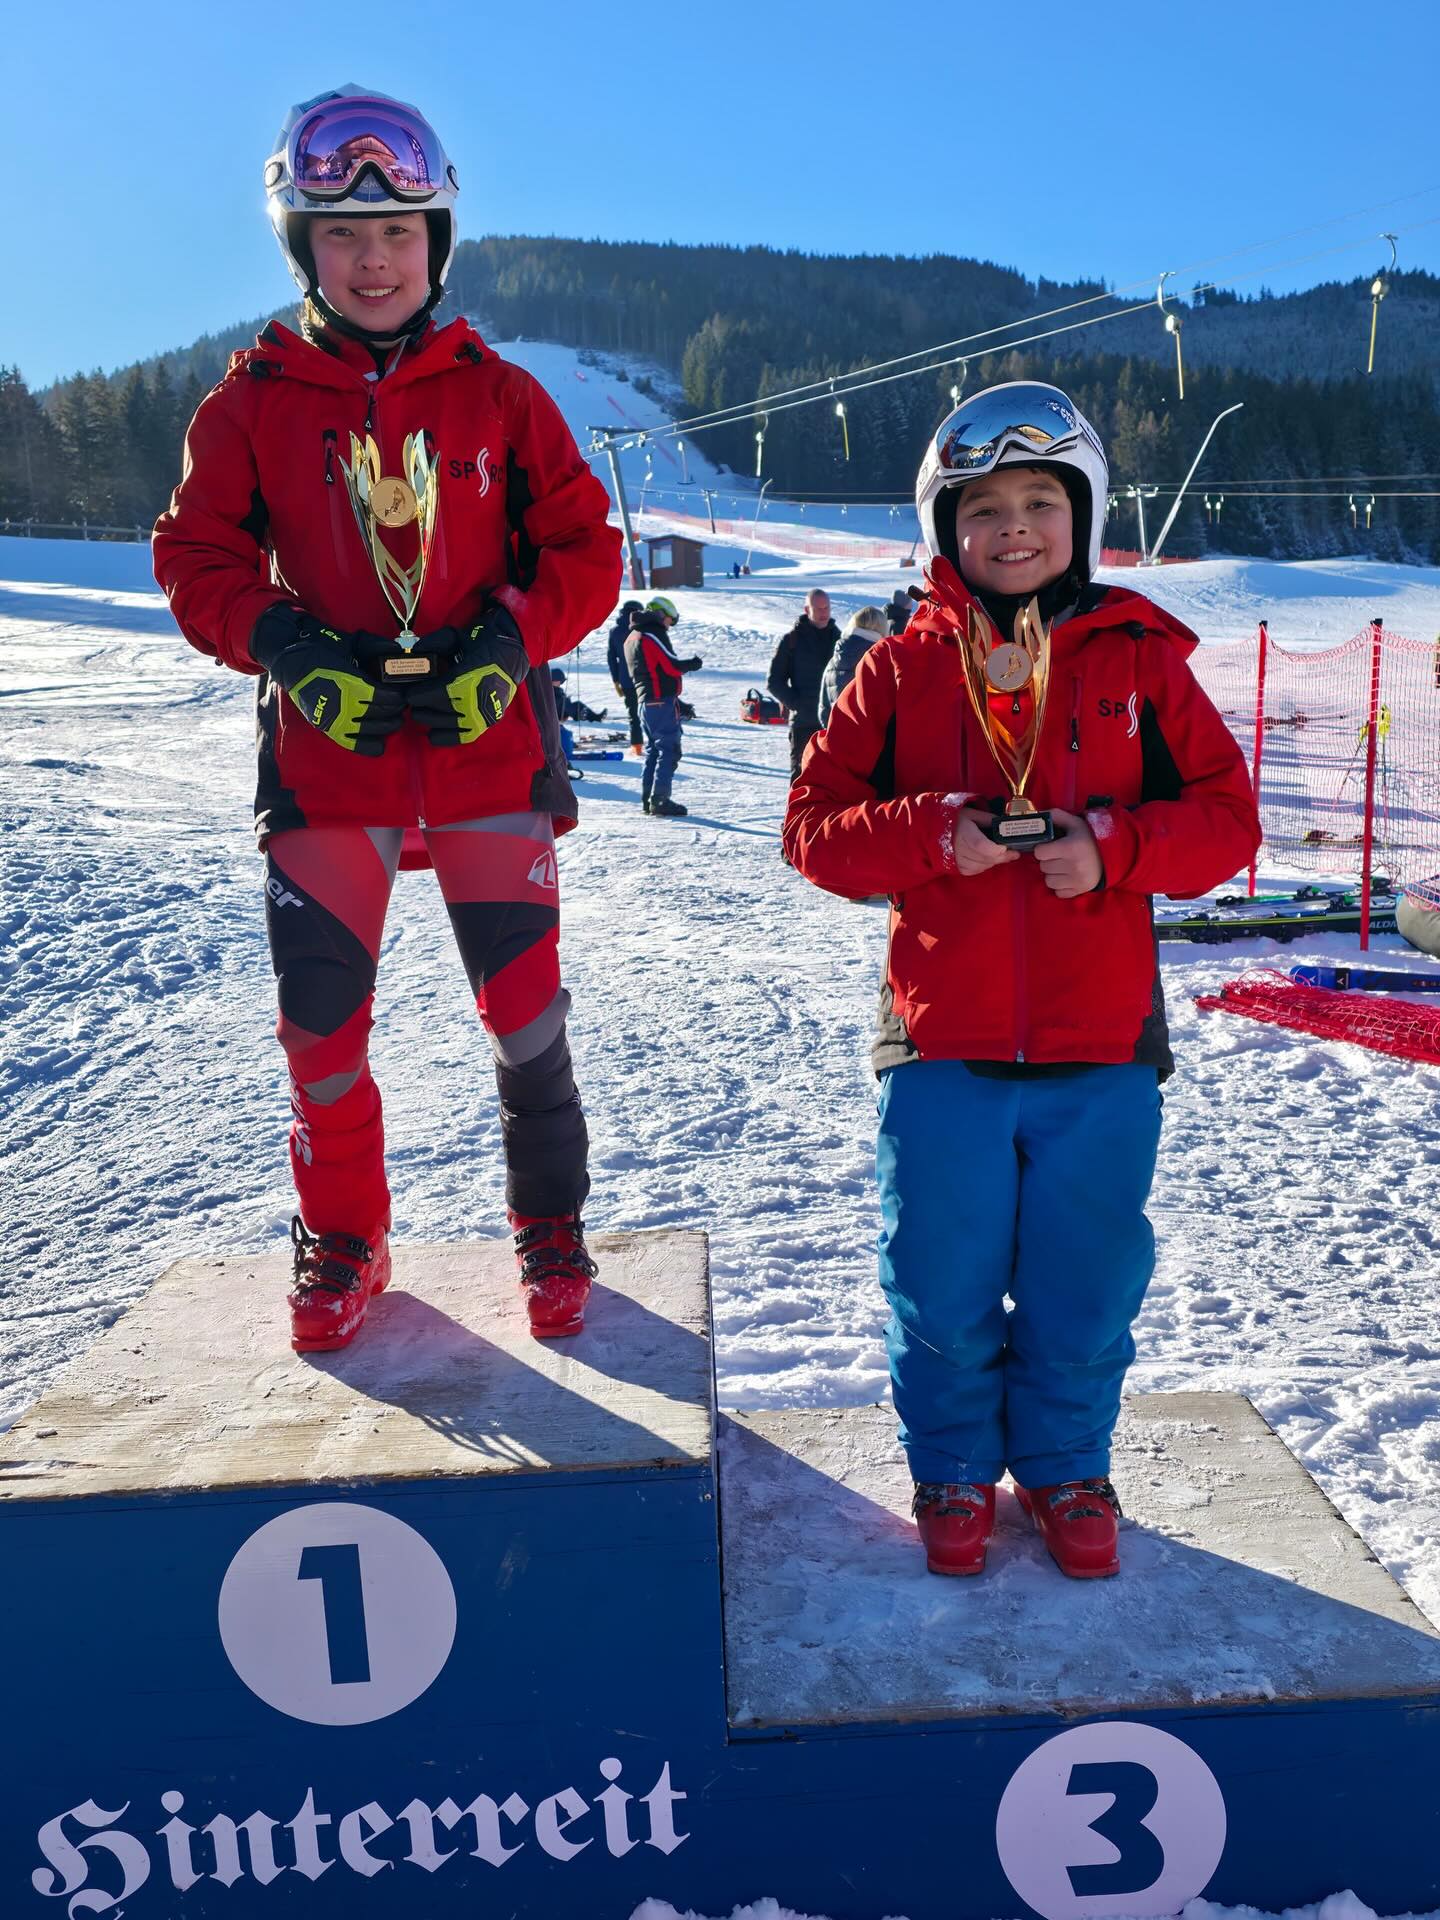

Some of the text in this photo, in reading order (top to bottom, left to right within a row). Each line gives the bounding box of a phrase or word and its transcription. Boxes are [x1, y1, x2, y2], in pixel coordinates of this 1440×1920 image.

[320, 629, 341, 642] LEK
[312, 695, 328, 725] LEKI
[297, 1543, 371, 1685] 1
[30, 1757, 691, 1920] Hinterreit
[1065, 1761, 1165, 1897] 3
